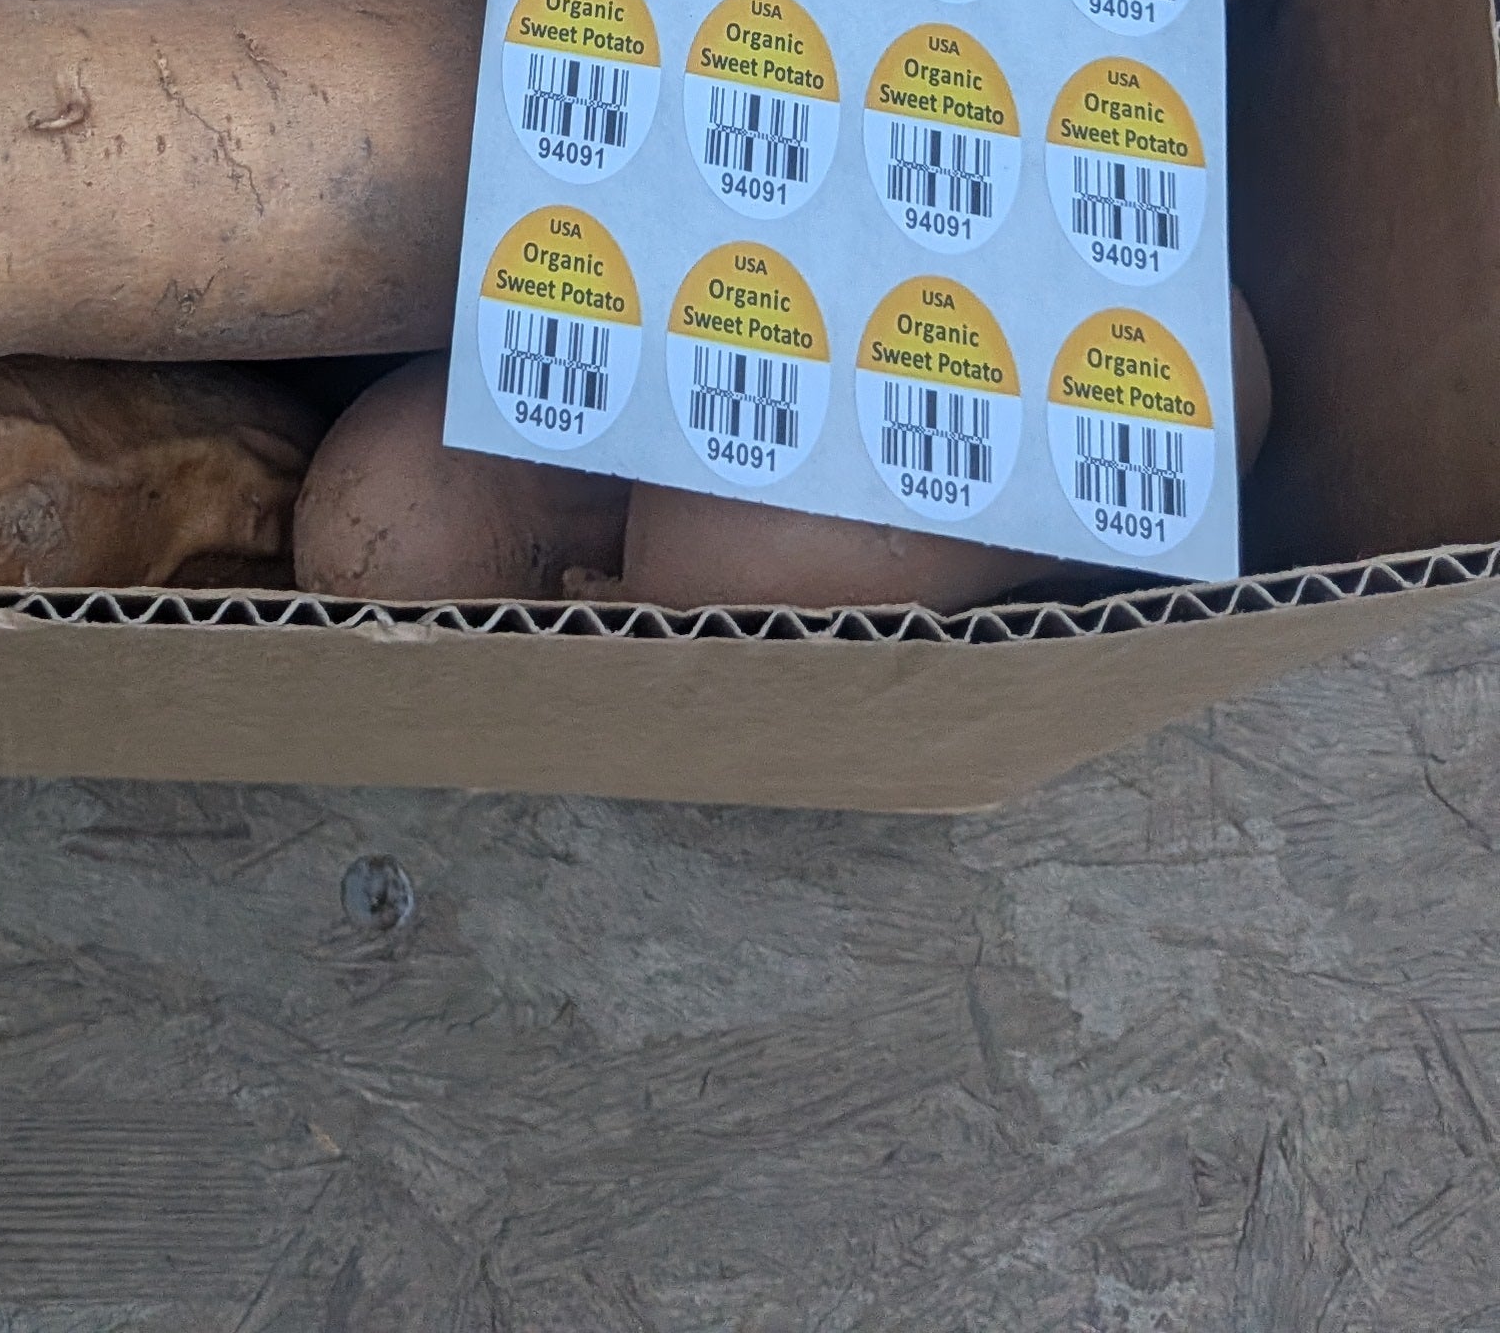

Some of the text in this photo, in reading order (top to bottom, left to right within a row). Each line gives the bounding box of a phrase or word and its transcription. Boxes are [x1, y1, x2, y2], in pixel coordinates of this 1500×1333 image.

[519, 17, 645, 55] Sweet Potato
[725, 21, 804, 55] Organic
[928, 32, 960, 54] USA
[700, 48, 824, 90] Sweet Potato
[903, 57, 983, 91] Organic
[1107, 66, 1140, 87] USA
[878, 84, 1005, 125] Sweet Potato
[1083, 91, 1165, 124] Organic
[537, 136, 604, 169] 94091
[1060, 118, 1188, 157] Sweet Potato
[720, 171, 786, 206] 94091
[550, 215, 582, 239] USA
[904, 206, 970, 240] 94091
[522, 241, 605, 278] Organic
[735, 251, 767, 275] USA
[1091, 240, 1158, 272] 94091
[495, 269, 625, 314] Sweet Potato
[708, 277, 791, 314] Organic
[922, 286, 955, 309] USA
[682, 305, 813, 350] Sweet Potato
[896, 312, 980, 348] Organic
[1111, 319, 1145, 343] USA
[871, 341, 1003, 385] Sweet Potato
[1086, 346, 1171, 382] Organic
[1062, 374, 1196, 418] Sweet Potato
[515, 398, 583, 434] 94091
[707, 434, 775, 471] 94091
[900, 470, 969, 506] 94091
[1095, 504, 1165, 541] 94091
